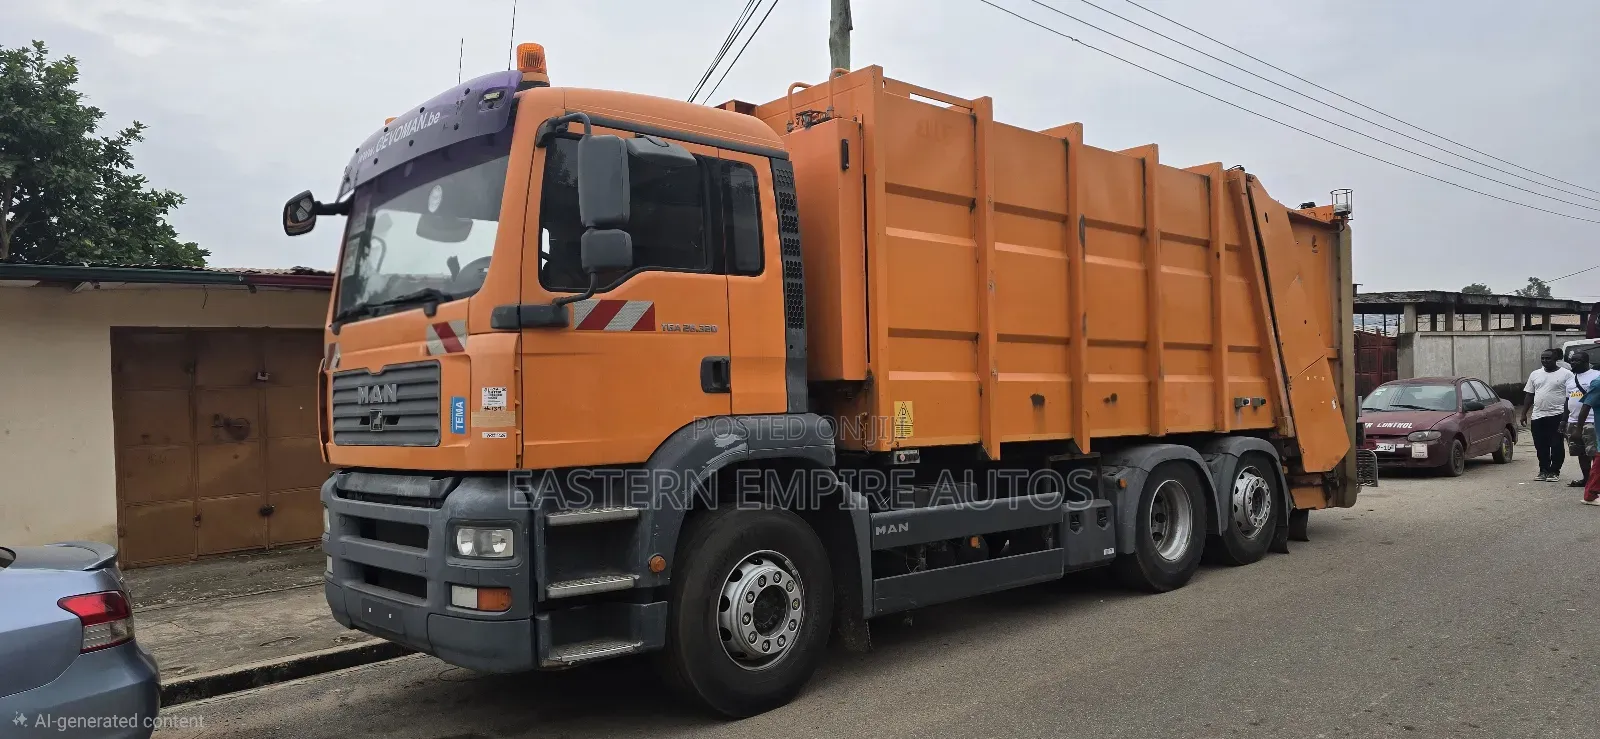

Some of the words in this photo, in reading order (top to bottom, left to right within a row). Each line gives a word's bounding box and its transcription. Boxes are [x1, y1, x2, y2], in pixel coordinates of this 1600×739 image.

[661, 323, 681, 332] TGA
[357, 383, 397, 404] MAN
[455, 401, 464, 431] TEMA
[875, 521, 909, 536] MAN
